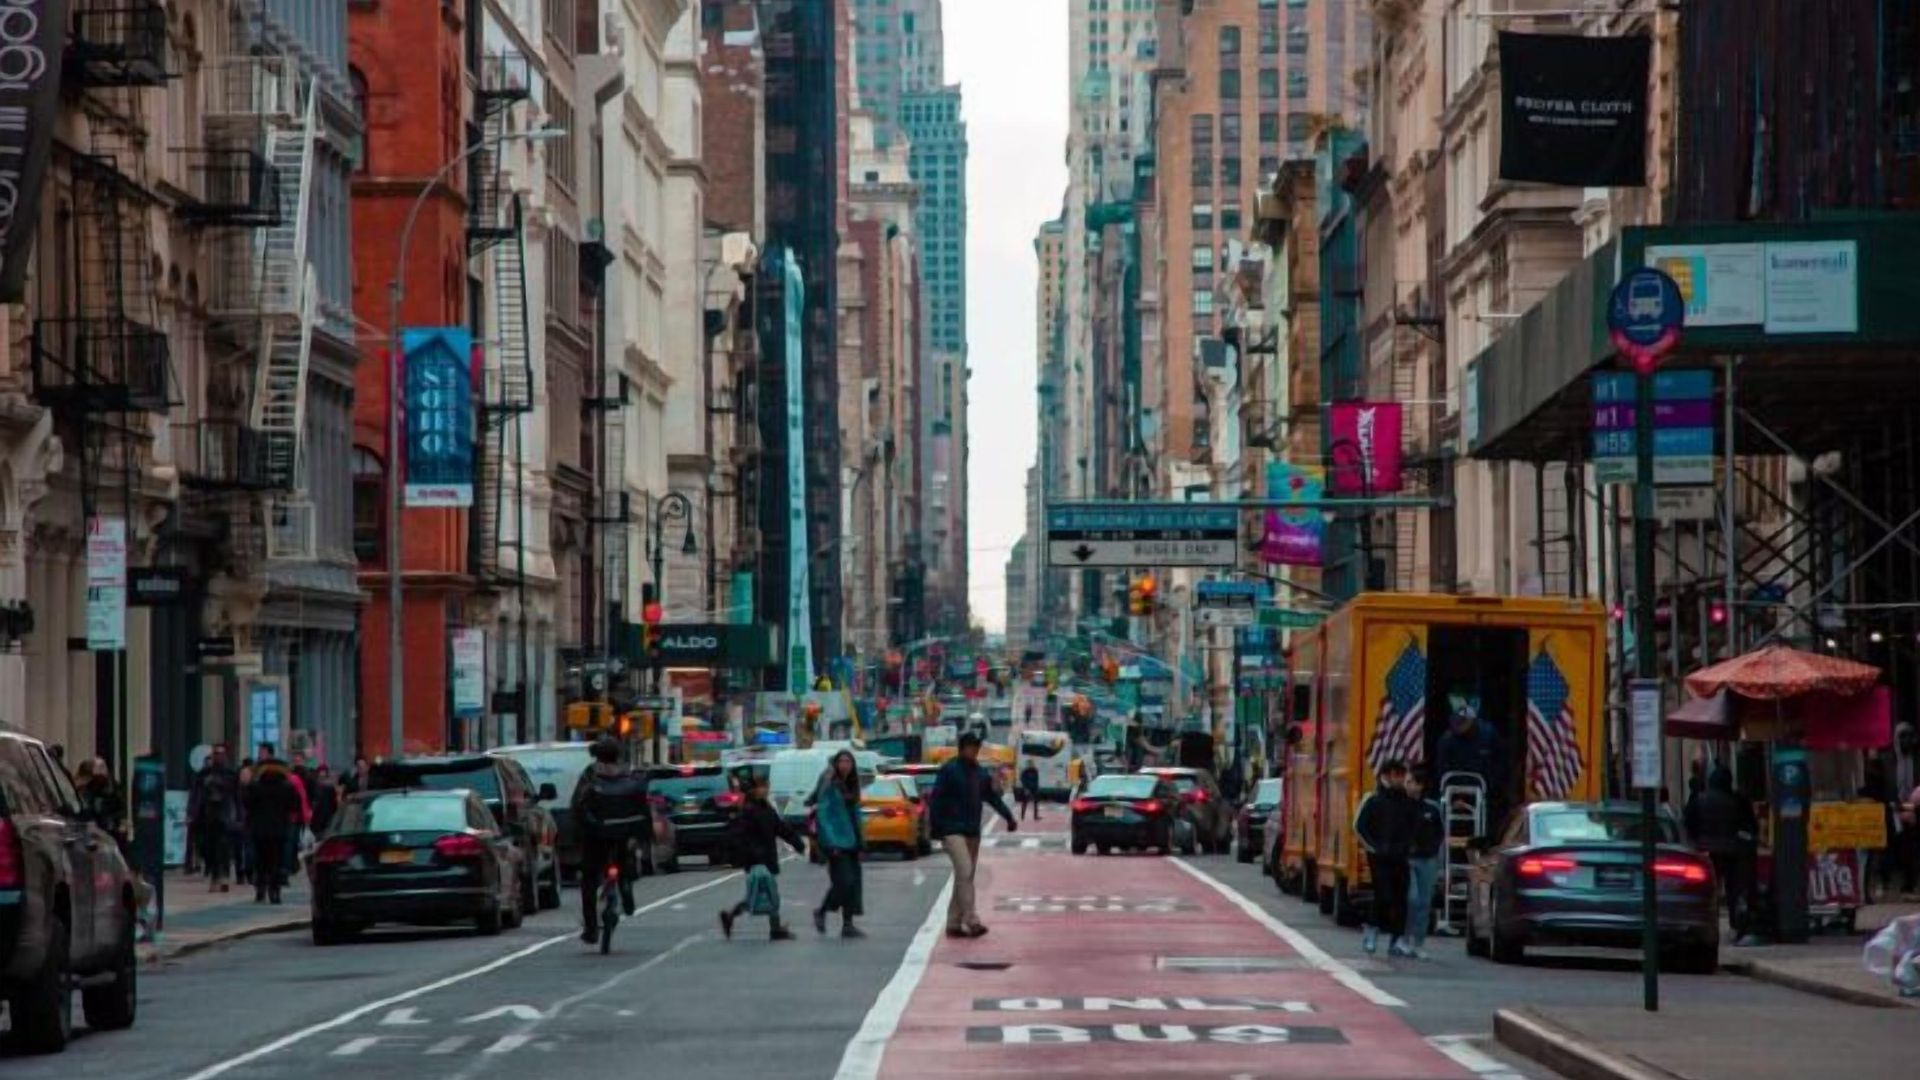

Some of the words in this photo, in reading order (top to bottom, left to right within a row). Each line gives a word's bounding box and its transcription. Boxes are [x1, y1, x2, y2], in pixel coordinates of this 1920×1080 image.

[662, 635, 718, 648] ALDO
[999, 997, 1313, 1012] ONLY
[1002, 1023, 1291, 1044] BUS
